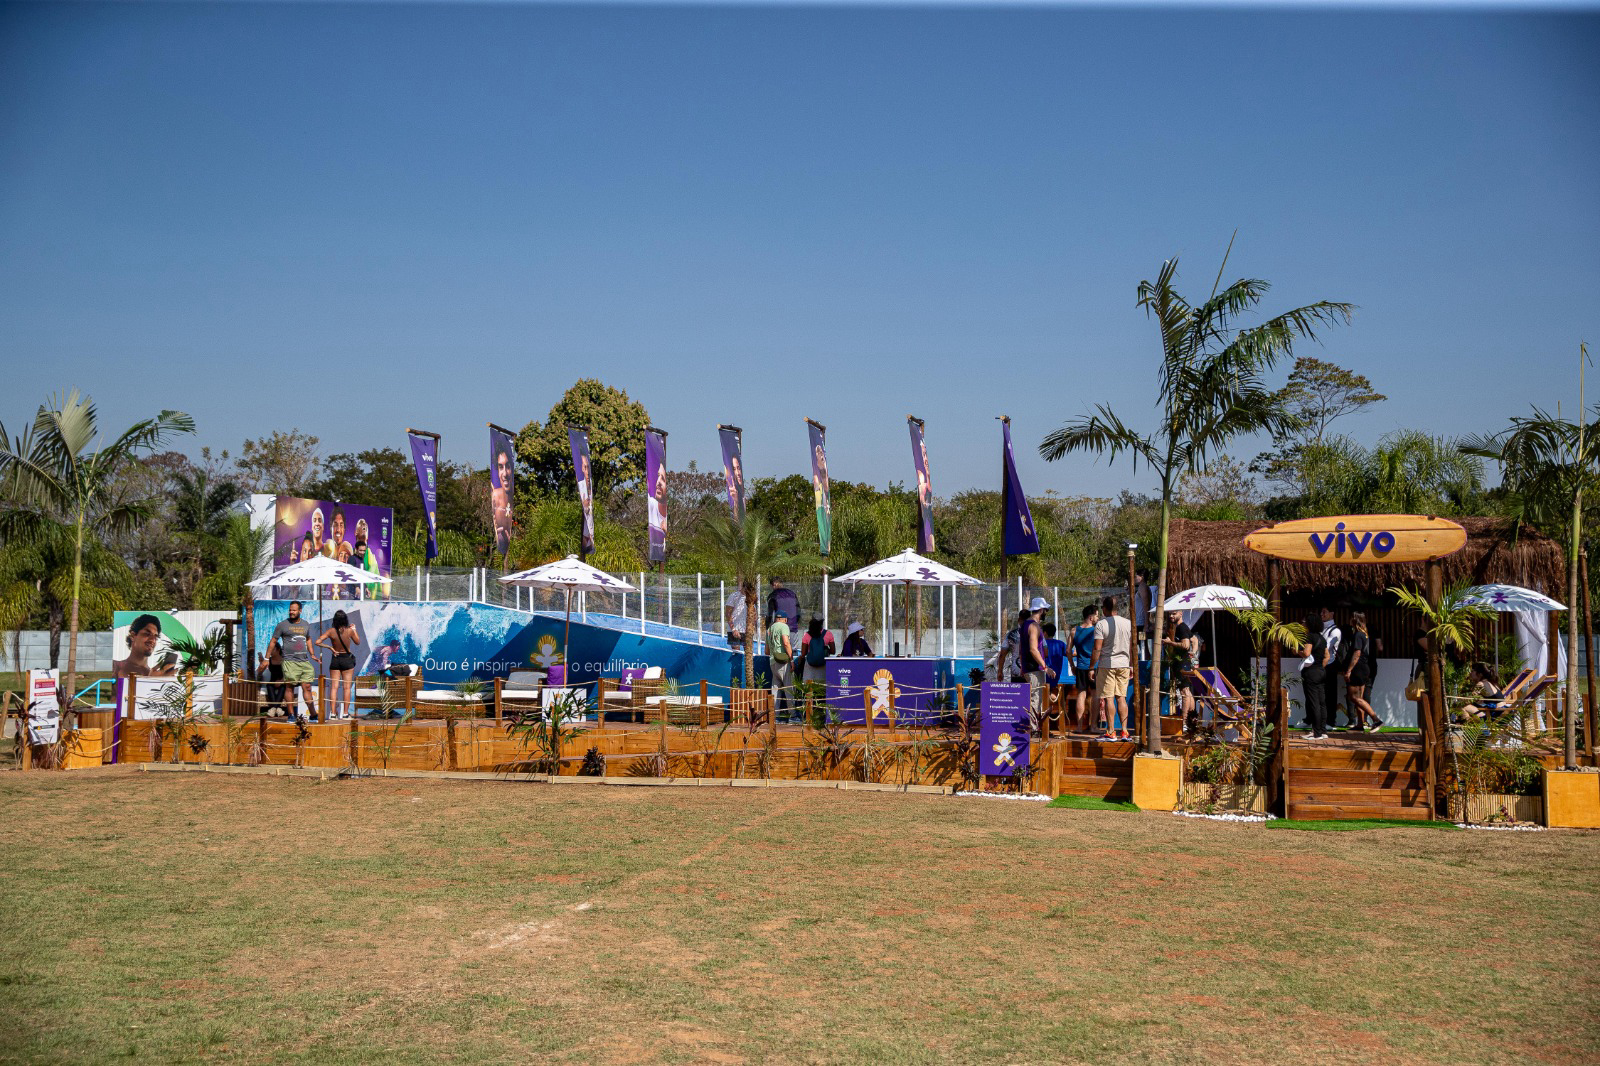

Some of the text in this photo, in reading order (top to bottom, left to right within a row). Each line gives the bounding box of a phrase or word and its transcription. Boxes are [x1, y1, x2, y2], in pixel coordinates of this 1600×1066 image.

[1310, 522, 1396, 555] vivo
[425, 657, 649, 675] Ouro é inspirar o equilíbrio
